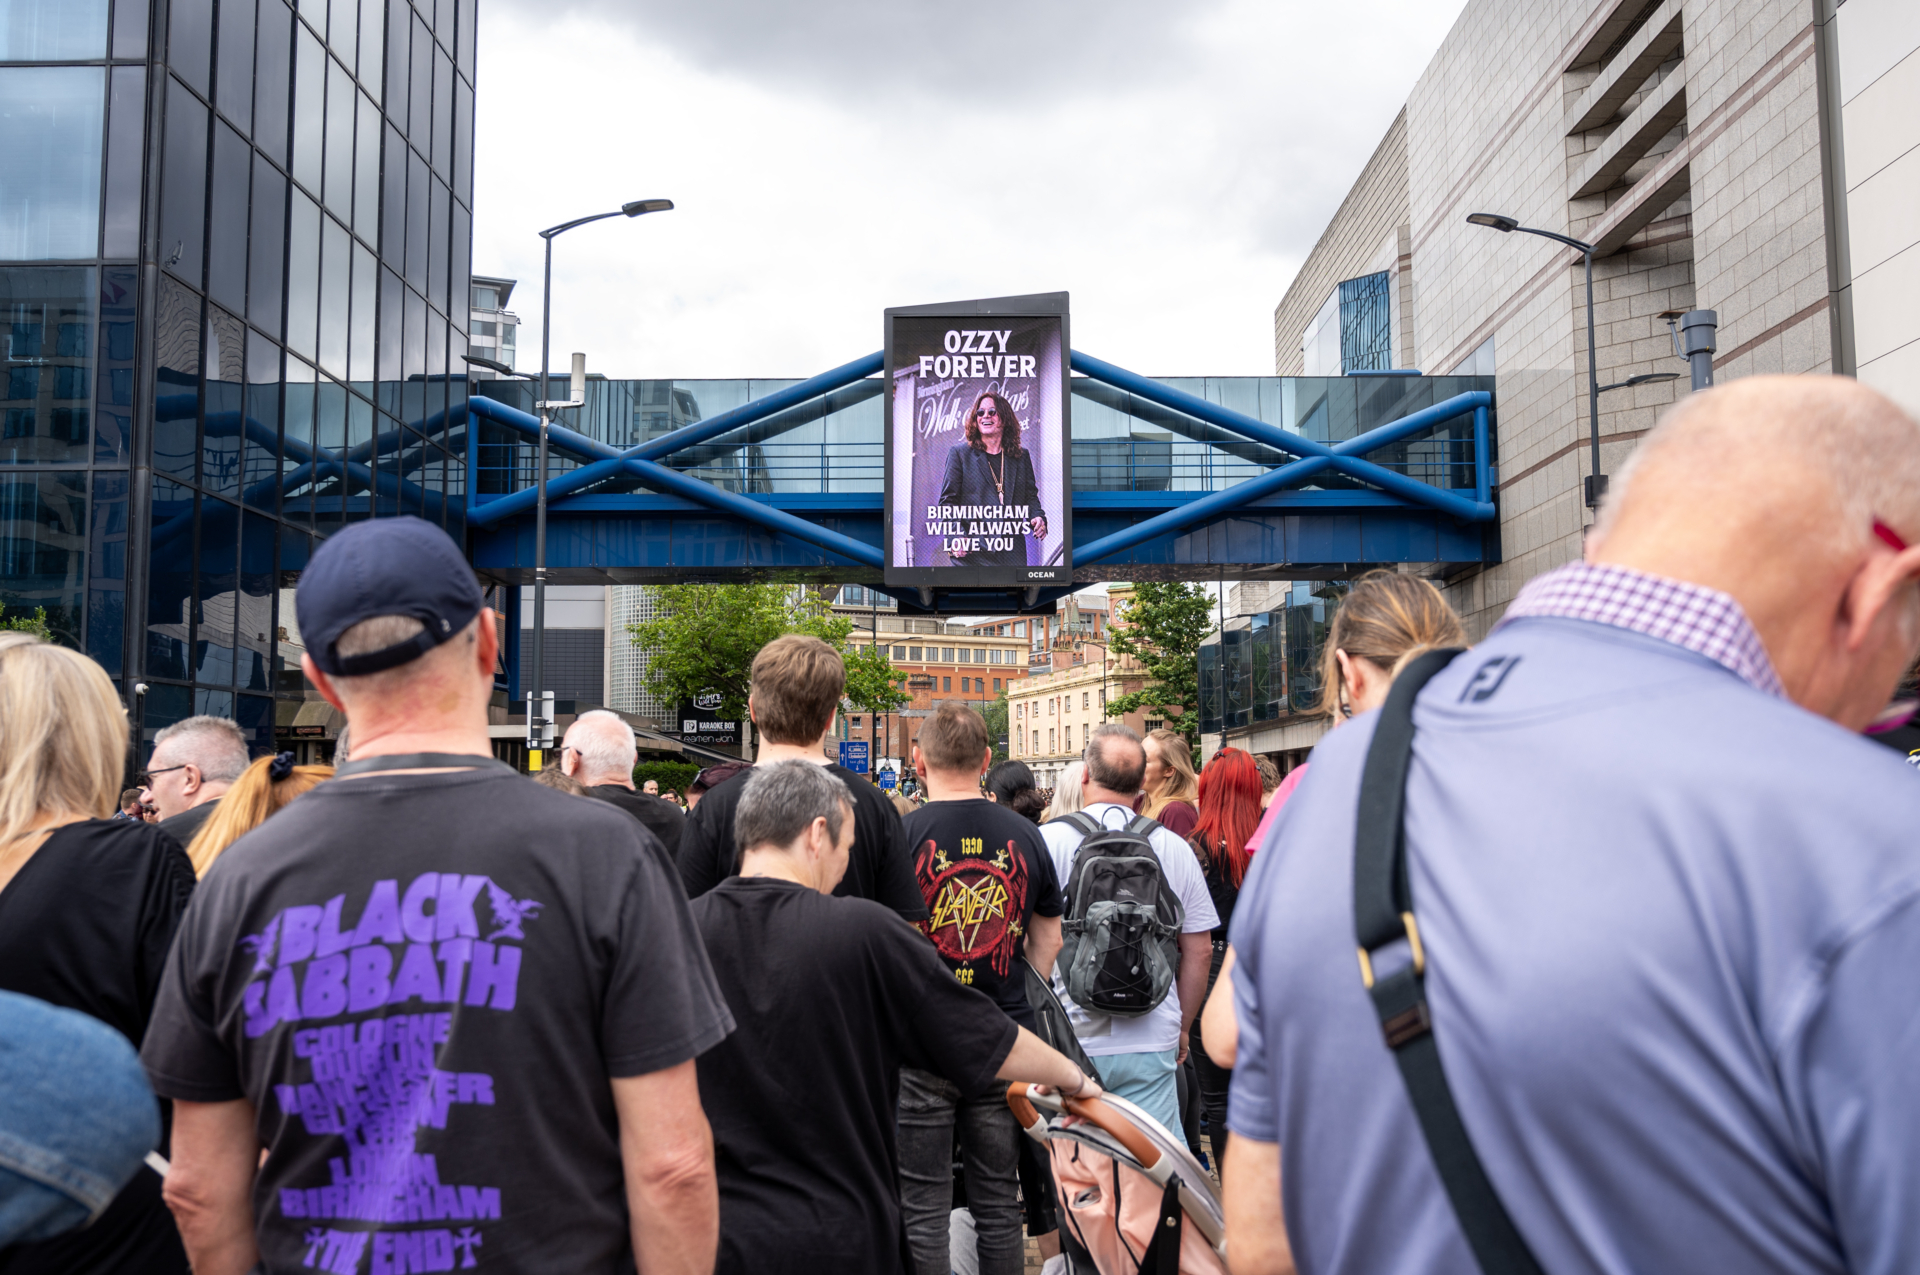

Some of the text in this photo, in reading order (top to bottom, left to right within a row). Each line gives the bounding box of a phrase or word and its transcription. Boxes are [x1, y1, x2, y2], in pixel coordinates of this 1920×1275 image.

[944, 330, 1012, 354] OZZY
[919, 355, 1036, 379] FOREVER
[927, 505, 1029, 520] BIRMINGHAM
[925, 521, 1031, 536] WILL ALWAYS
[943, 537, 1014, 552] LOVE YOU
[1028, 571, 1055, 579] OCEAN
[699, 722, 735, 730] KARAOKE BOX
[961, 837, 983, 855] 1990
[277, 872, 491, 966] BLACK
[929, 884, 1009, 933] SLAYER
[243, 938, 523, 1038] SABBATH
[293, 1012, 452, 1058] COLOGNE
[370, 1229, 456, 1275] END
